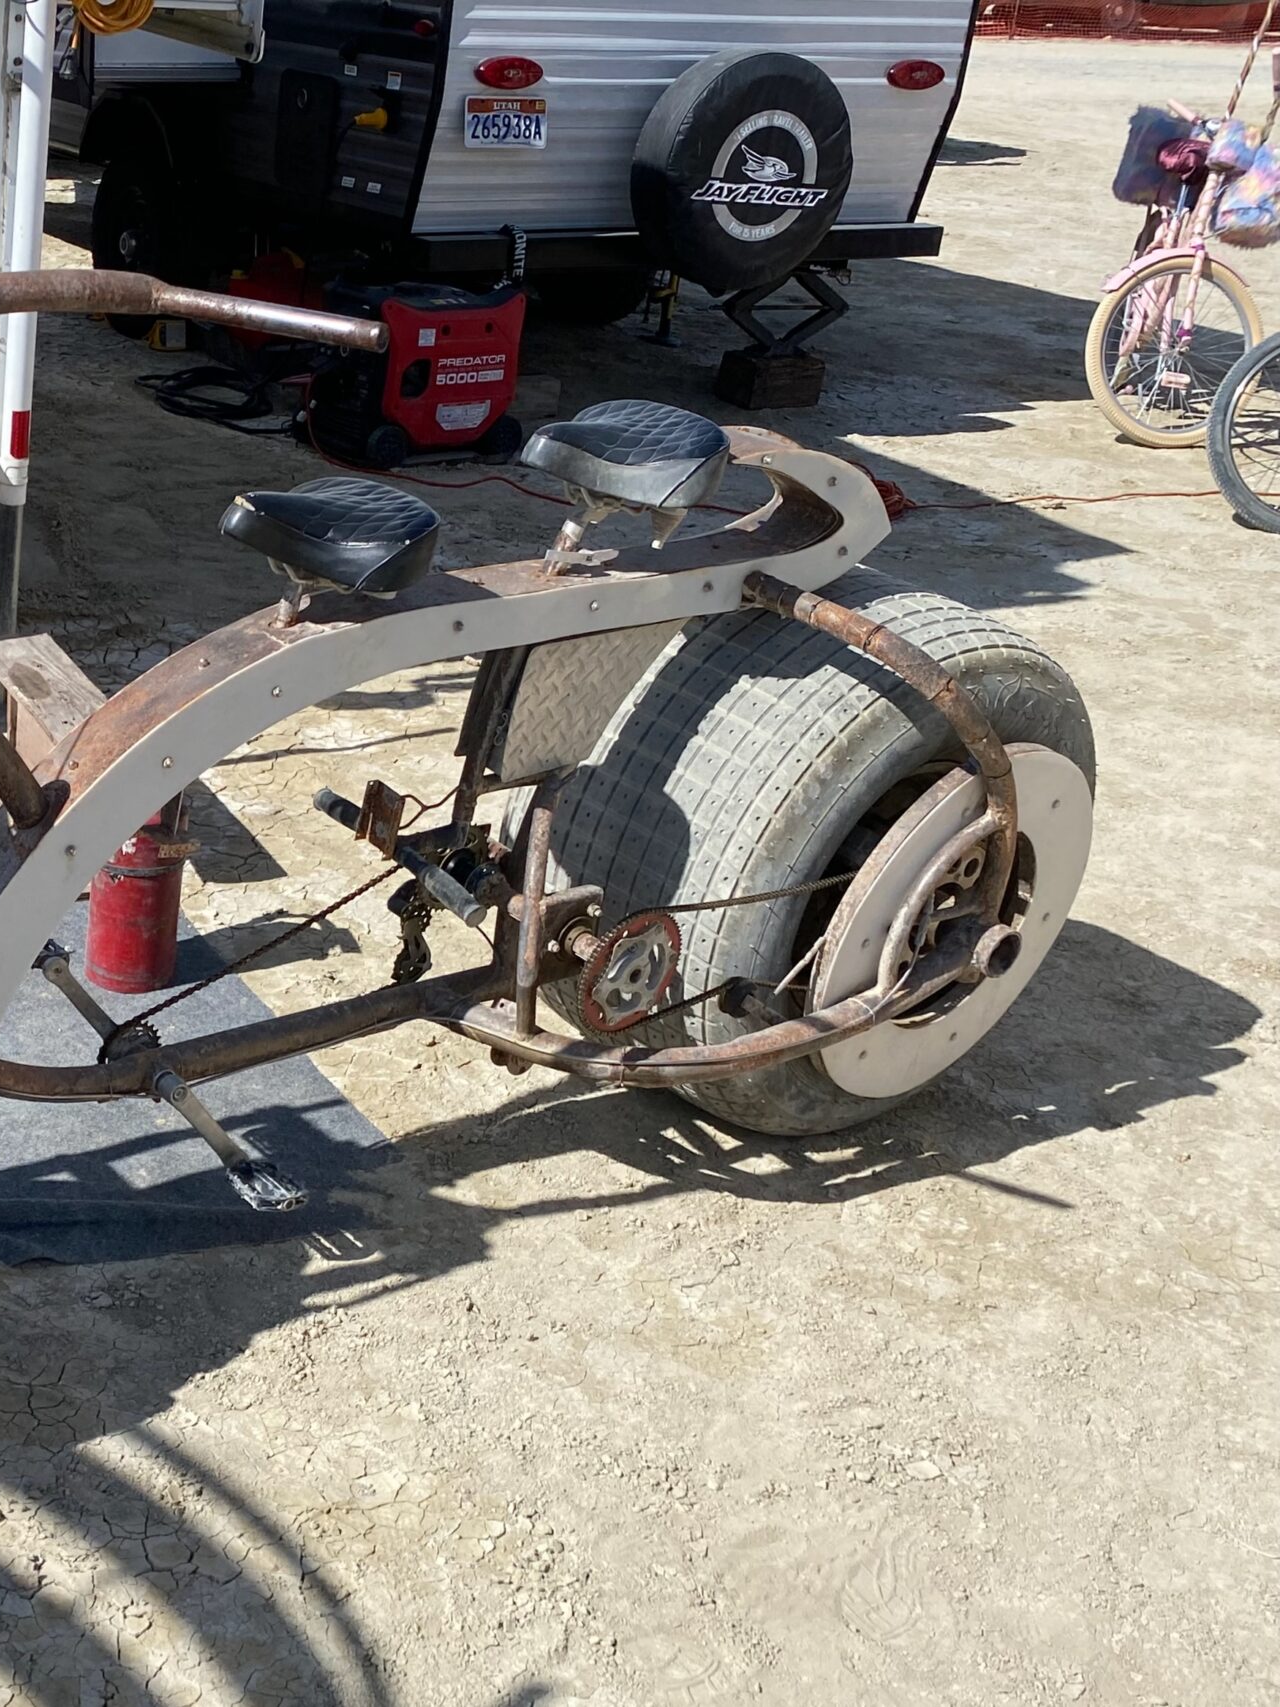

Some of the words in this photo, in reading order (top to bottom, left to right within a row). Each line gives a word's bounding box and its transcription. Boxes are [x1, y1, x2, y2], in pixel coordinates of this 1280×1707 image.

[493, 102, 521, 110] UTAH
[471, 114, 542, 140] 265938A
[751, 225, 776, 239] YEARS
[438, 354, 506, 367] PREDATOR
[436, 372, 477, 385] 5000
